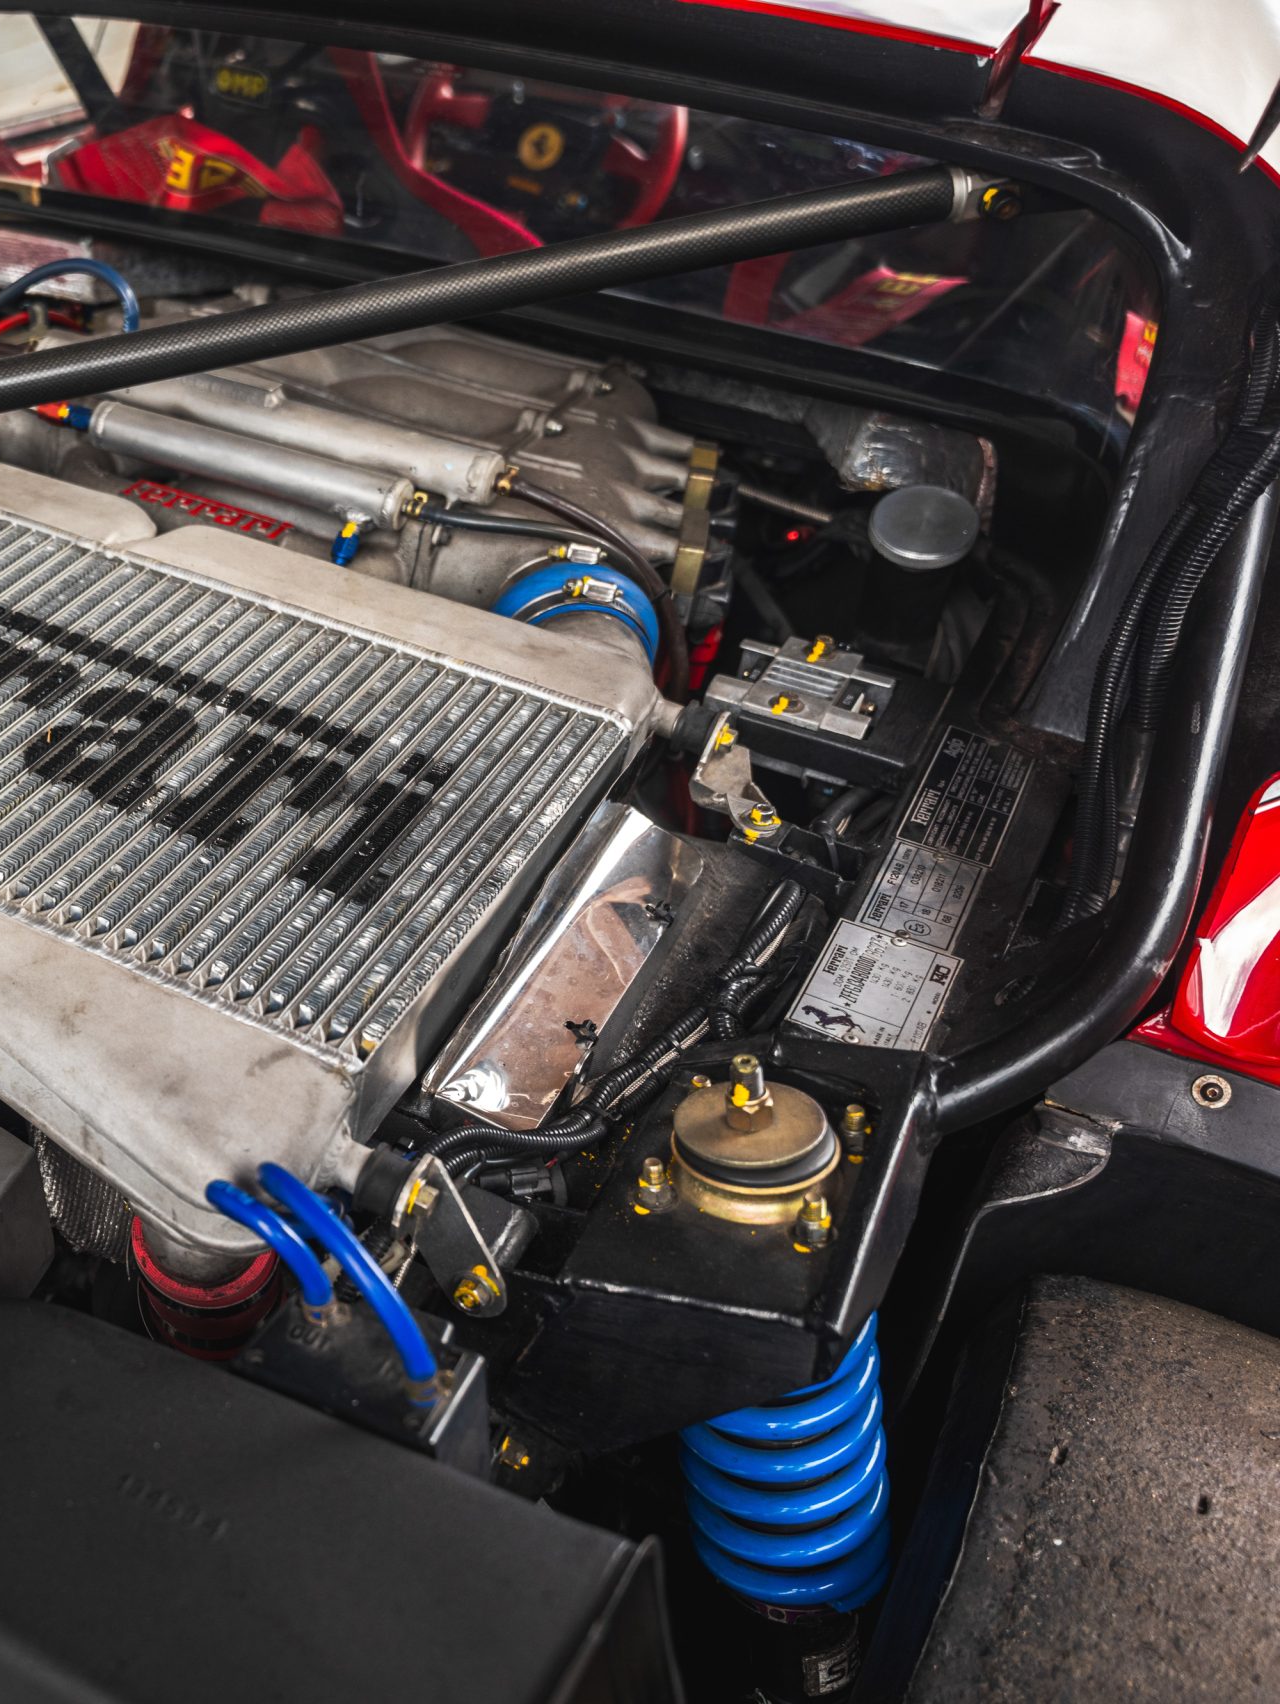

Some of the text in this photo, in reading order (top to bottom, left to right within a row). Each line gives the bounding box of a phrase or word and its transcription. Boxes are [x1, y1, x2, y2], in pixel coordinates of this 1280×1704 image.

[121, 479, 295, 541] Ferrari
[910, 787, 942, 827] Ferrari
[868, 862, 906, 923] Ferrari F120AB
[899, 901, 910, 909] 17
[822, 944, 849, 976] Ferrari
[929, 963, 952, 986] F40
